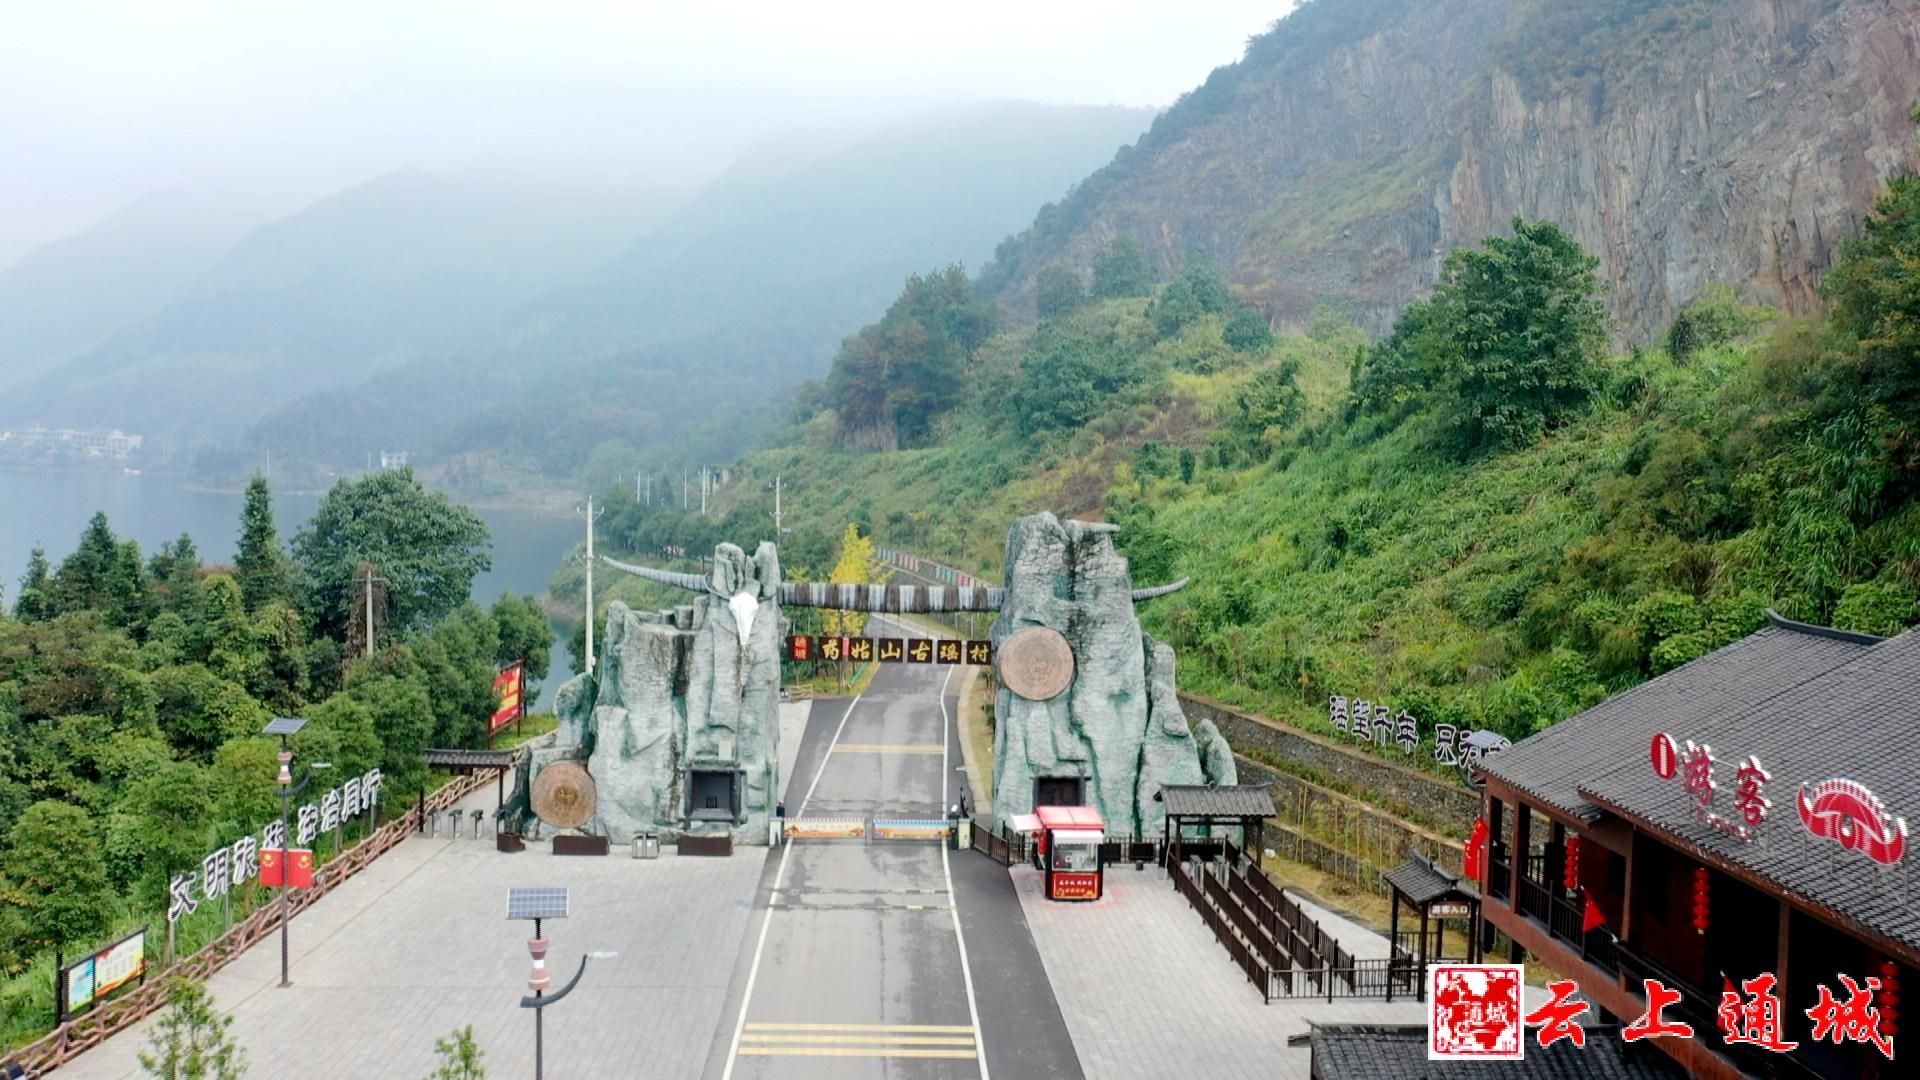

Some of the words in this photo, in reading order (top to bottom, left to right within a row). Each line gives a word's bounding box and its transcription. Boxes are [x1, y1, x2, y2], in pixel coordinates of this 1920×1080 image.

[822, 638, 990, 662] 药姑山古瑶村
